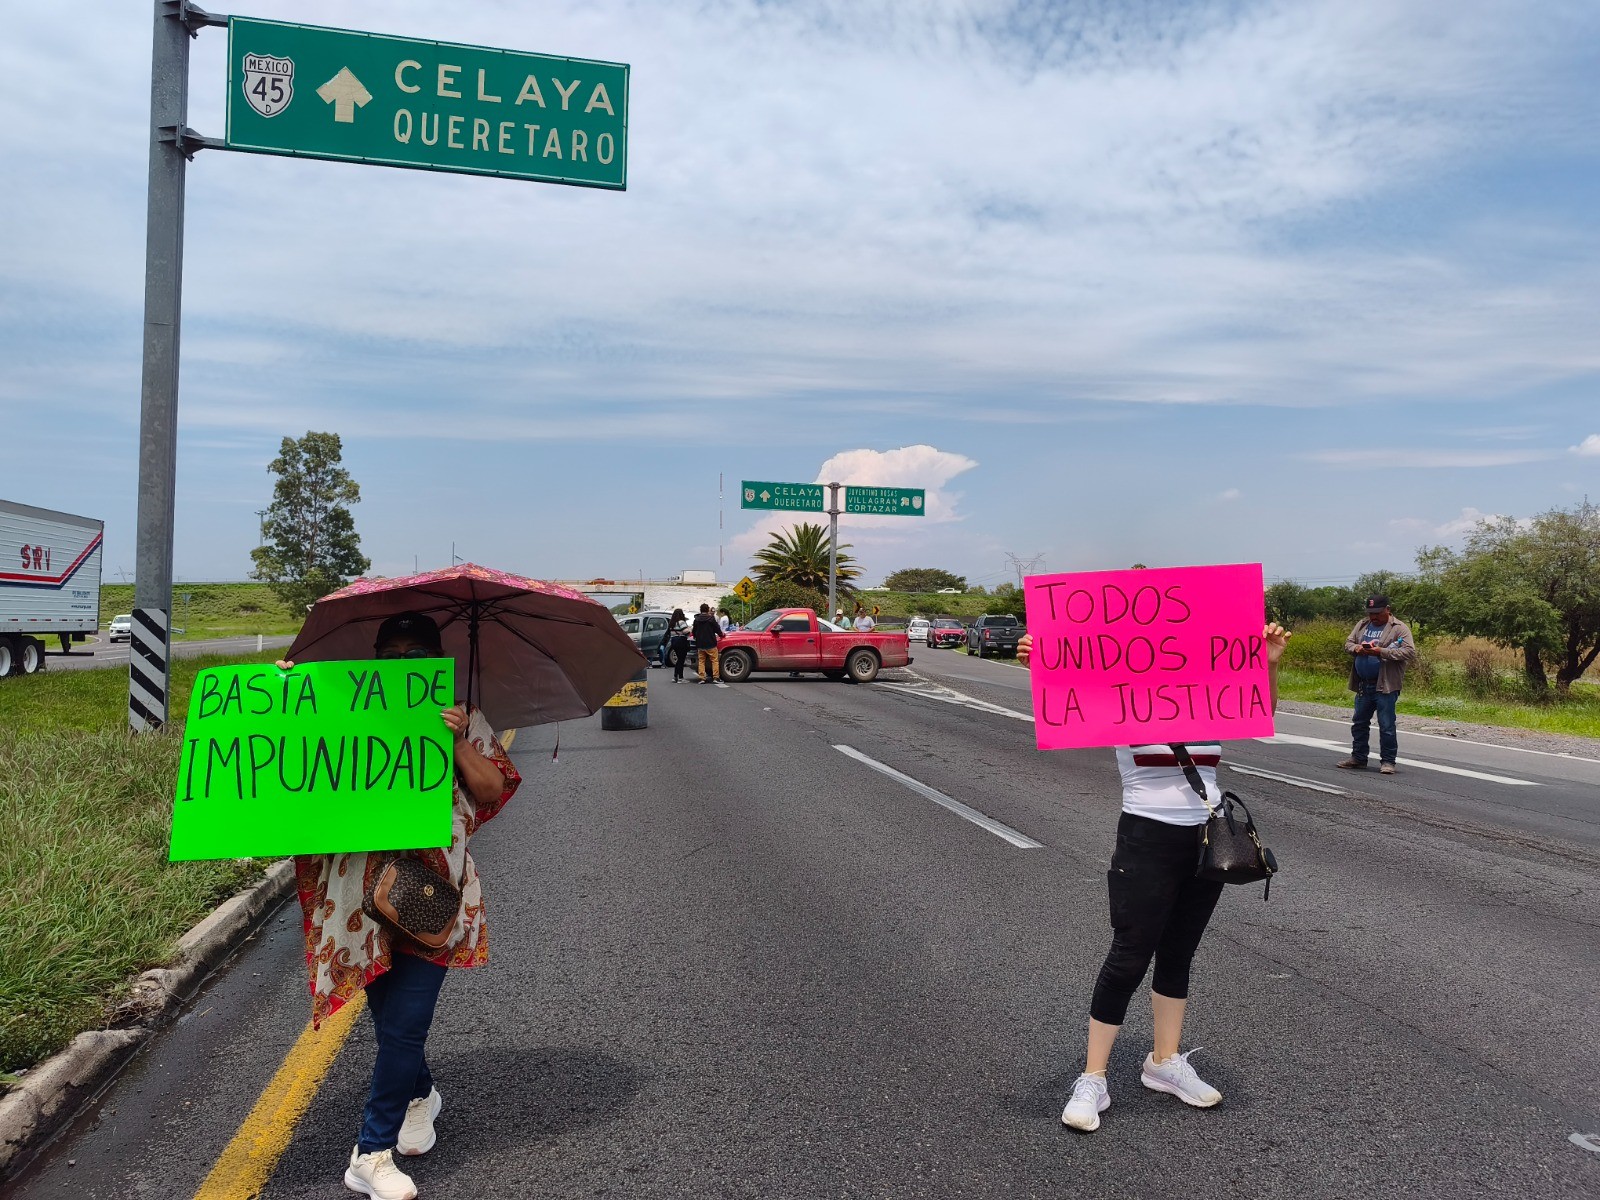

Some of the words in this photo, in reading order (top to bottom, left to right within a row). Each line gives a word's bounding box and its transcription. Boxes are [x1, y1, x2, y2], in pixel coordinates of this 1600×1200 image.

[249, 59, 289, 74] MEXICO
[252, 77, 284, 103] 45
[394, 59, 615, 116] CELAYA
[265, 104, 272, 113] D
[393, 108, 615, 165] QUERETARO
[774, 486, 821, 497] CELAYA
[774, 497, 821, 508] QUERETARO
[848, 496, 898, 505] VILLAGRAN
[847, 504, 897, 513] CORTAZAR
[1034, 581, 1191, 626] TODOS
[1039, 634, 1188, 674] UNIDOS
[1210, 634, 1265, 672] POR
[198, 673, 318, 720] BASTA
[348, 670, 388, 712] YA
[406, 670, 448, 709] DE
[1042, 687, 1086, 727] LA
[1110, 682, 1268, 725] JUSTICIA
[181, 734, 450, 802] IMPUNIDAD
